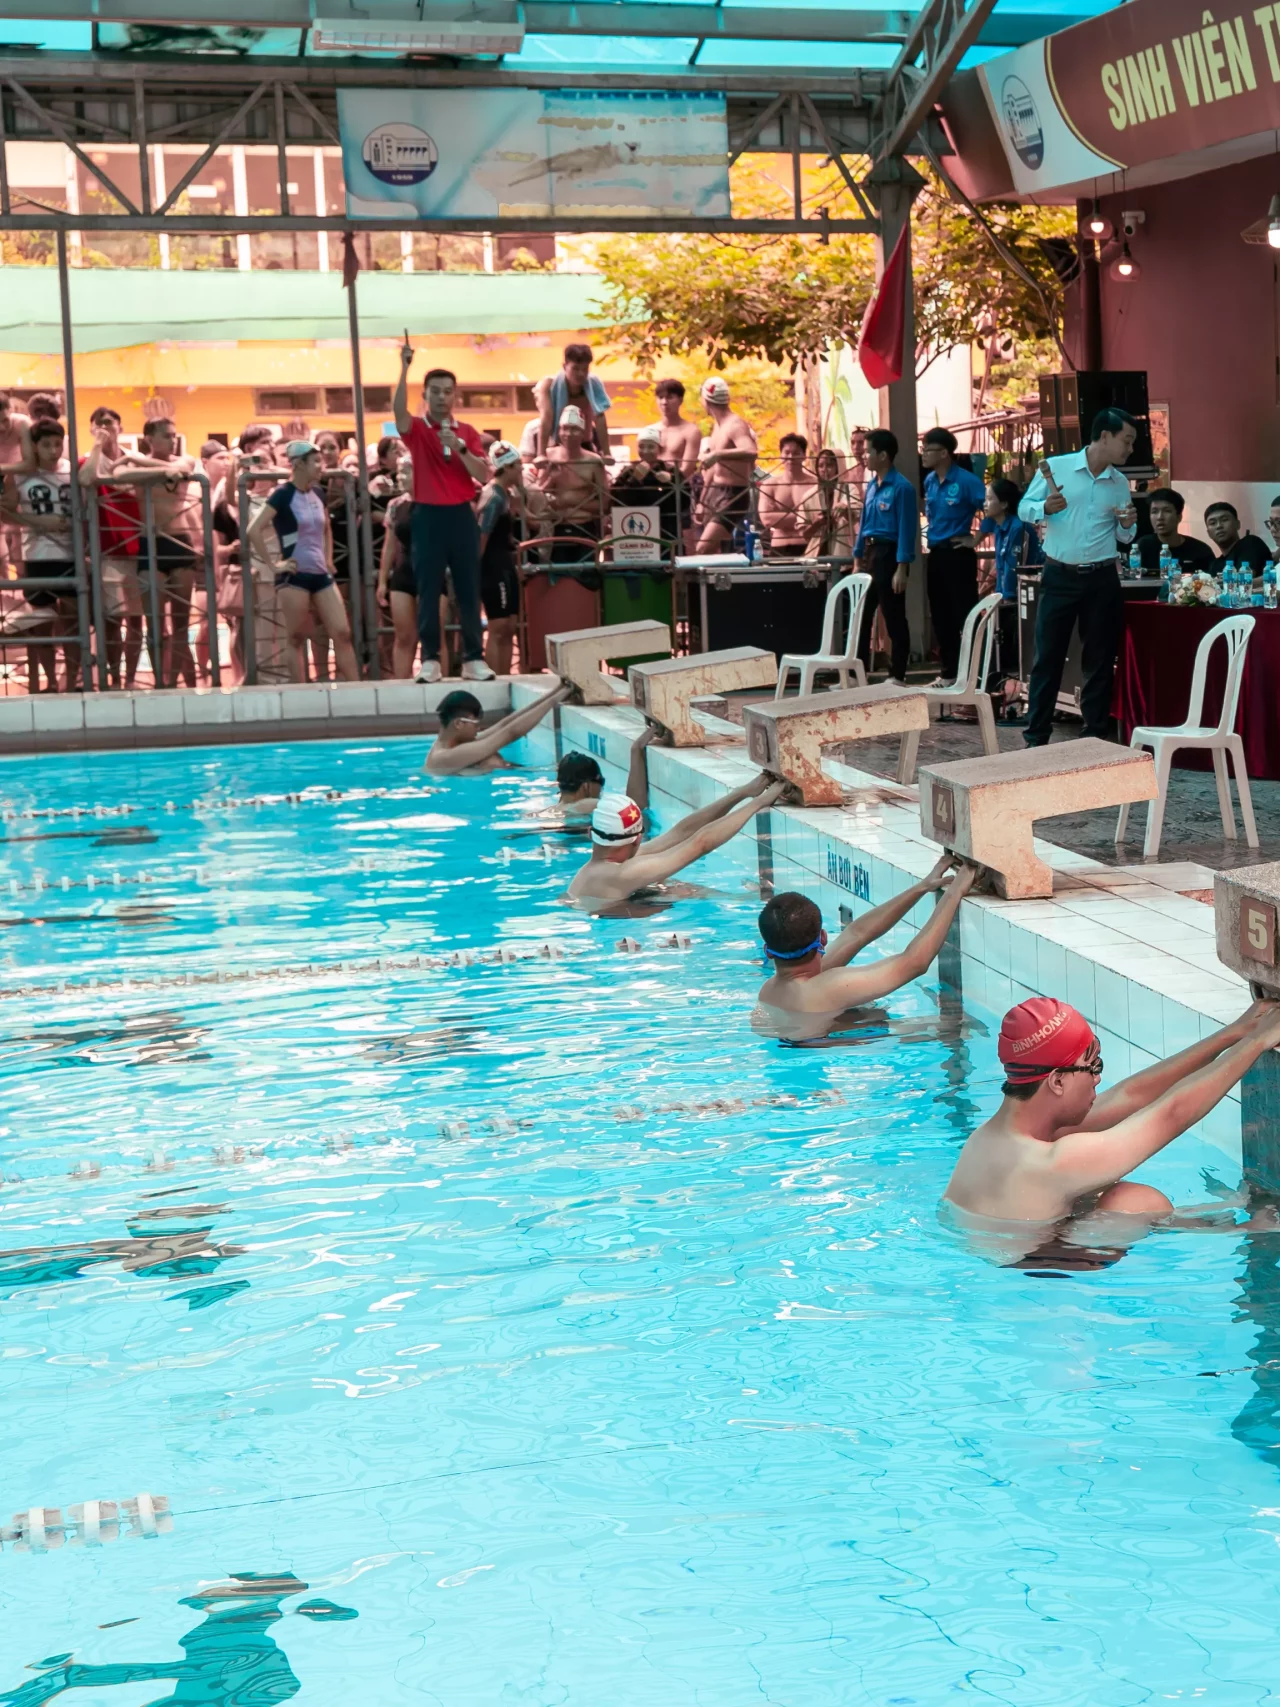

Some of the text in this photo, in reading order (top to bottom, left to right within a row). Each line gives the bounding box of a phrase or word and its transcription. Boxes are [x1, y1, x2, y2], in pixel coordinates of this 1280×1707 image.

[1101, 44, 1176, 131] SINH
[1172, 10, 1257, 107] VIÊN
[755, 731, 765, 756] 3
[936, 793, 948, 823] 4
[1248, 908, 1268, 950] 5
